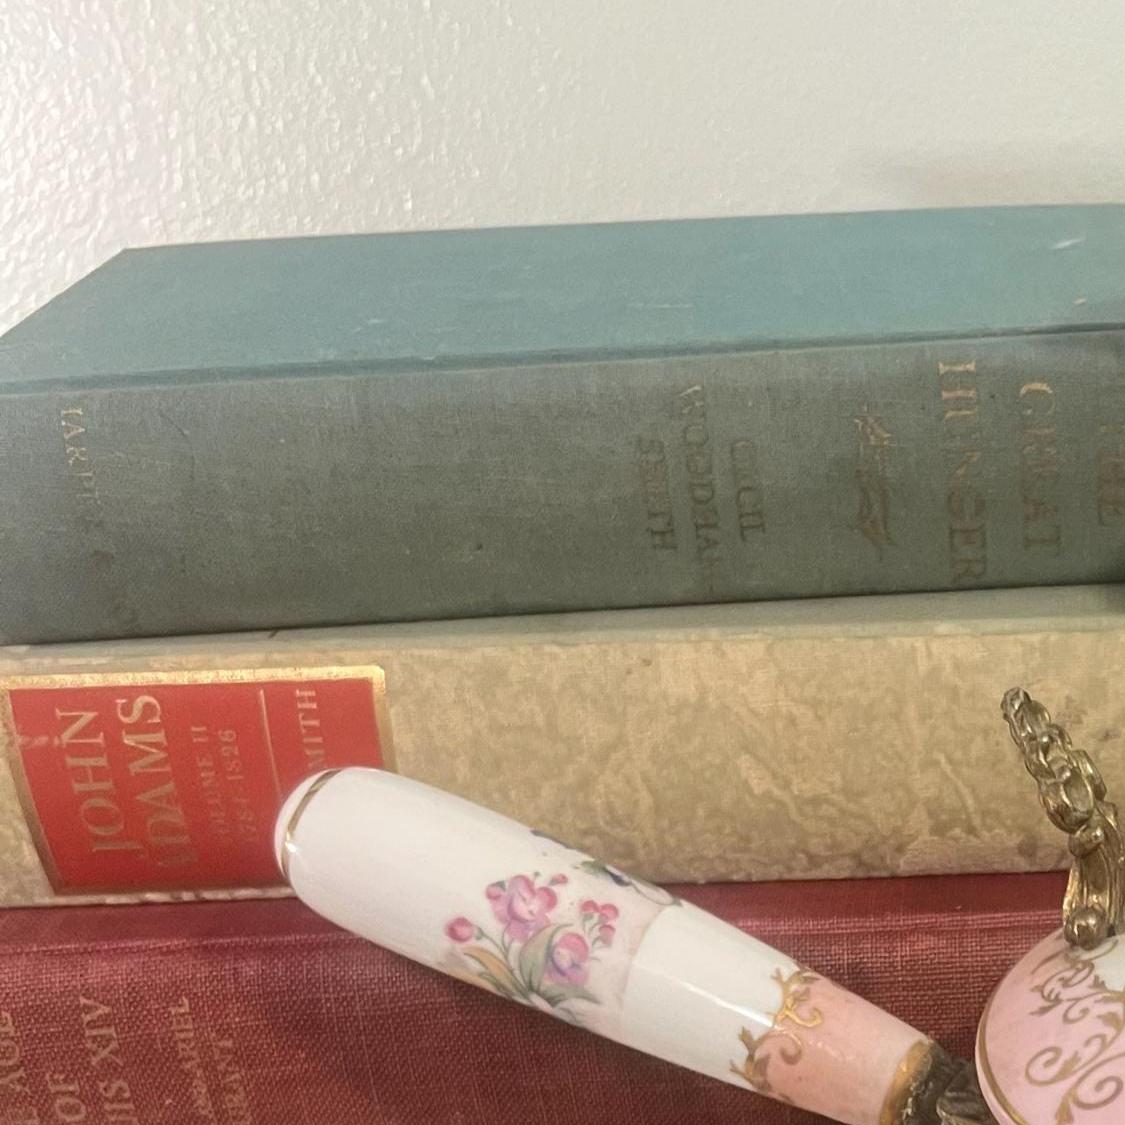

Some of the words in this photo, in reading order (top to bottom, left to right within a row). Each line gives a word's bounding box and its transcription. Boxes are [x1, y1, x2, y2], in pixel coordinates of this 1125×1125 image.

[294, 688, 326, 770] MITH
[56, 707, 144, 854] JOHN
[79, 996, 124, 1068] XIV
[46, 1073, 87, 1123] OF
